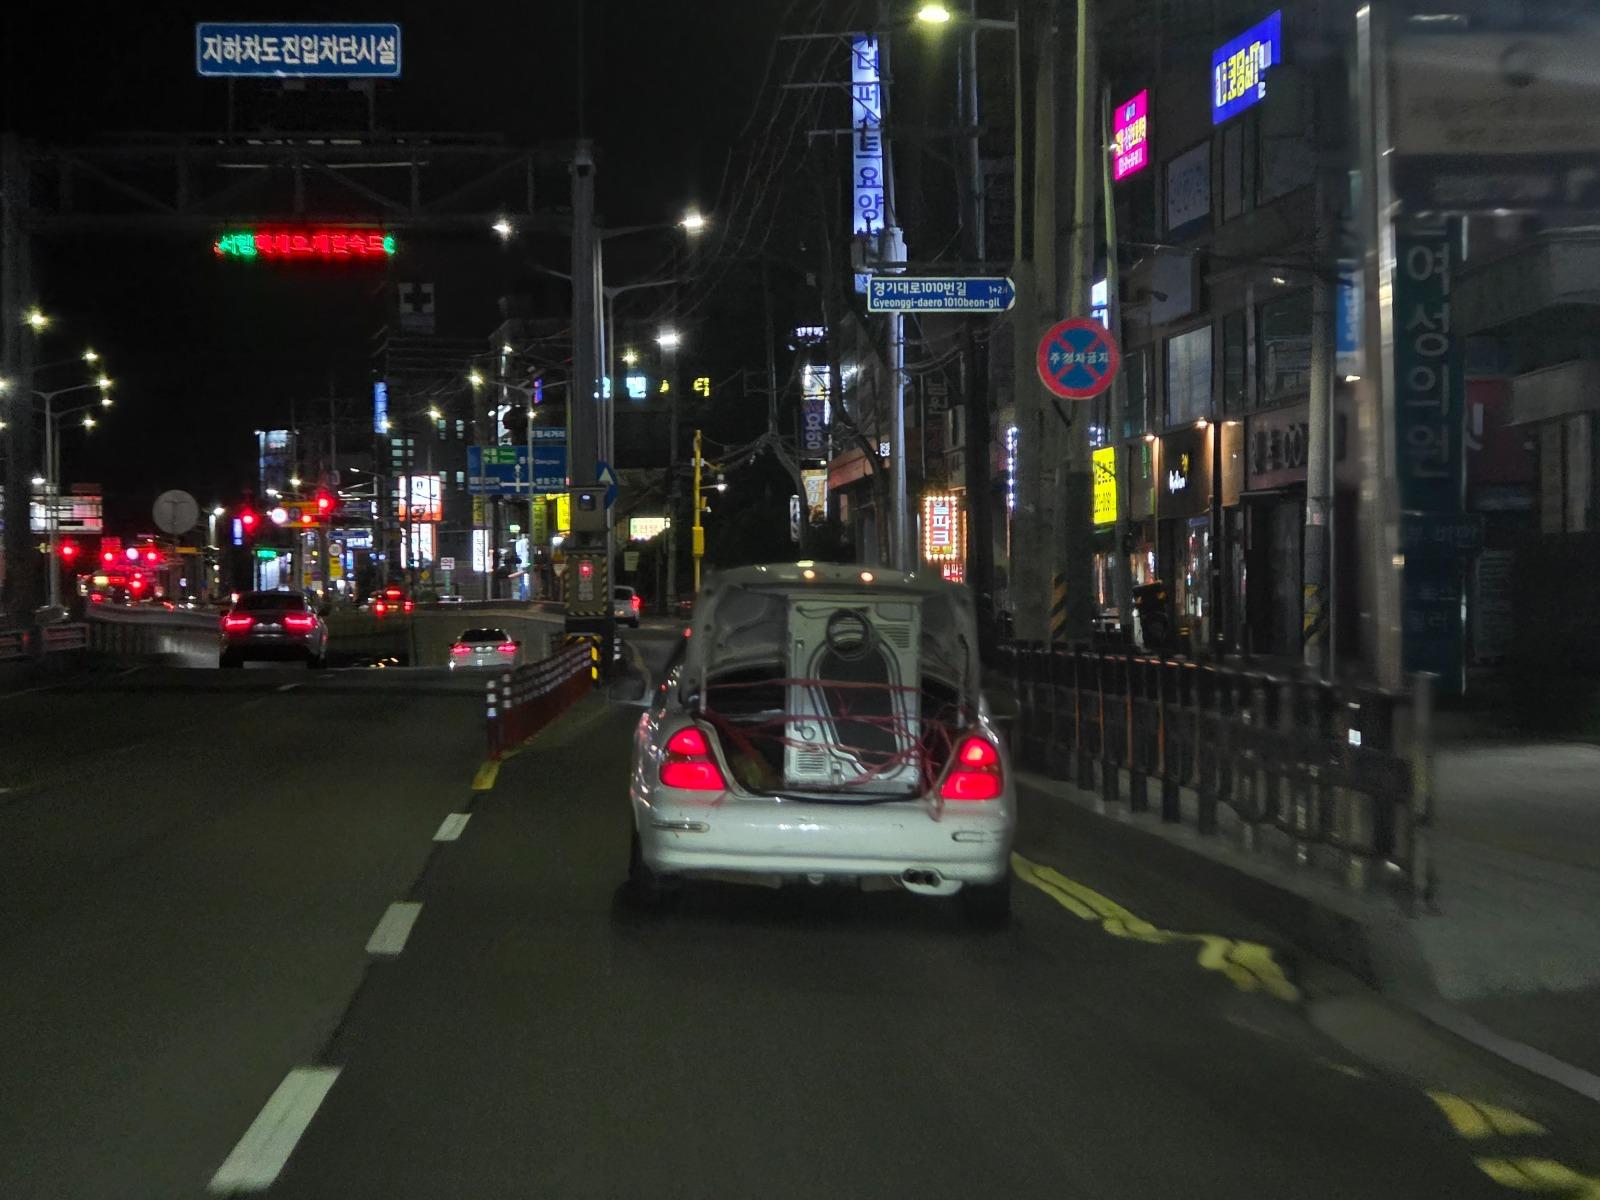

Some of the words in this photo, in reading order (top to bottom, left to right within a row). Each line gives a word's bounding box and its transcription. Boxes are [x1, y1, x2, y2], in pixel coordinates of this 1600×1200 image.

[203, 34, 396, 65] 지하차도진입차단시설
[873, 281, 967, 297] 경기대로1010번길
[873, 297, 943, 309] Gyeonggi-daero
[944, 297, 1001, 308] 1010beon-gil
